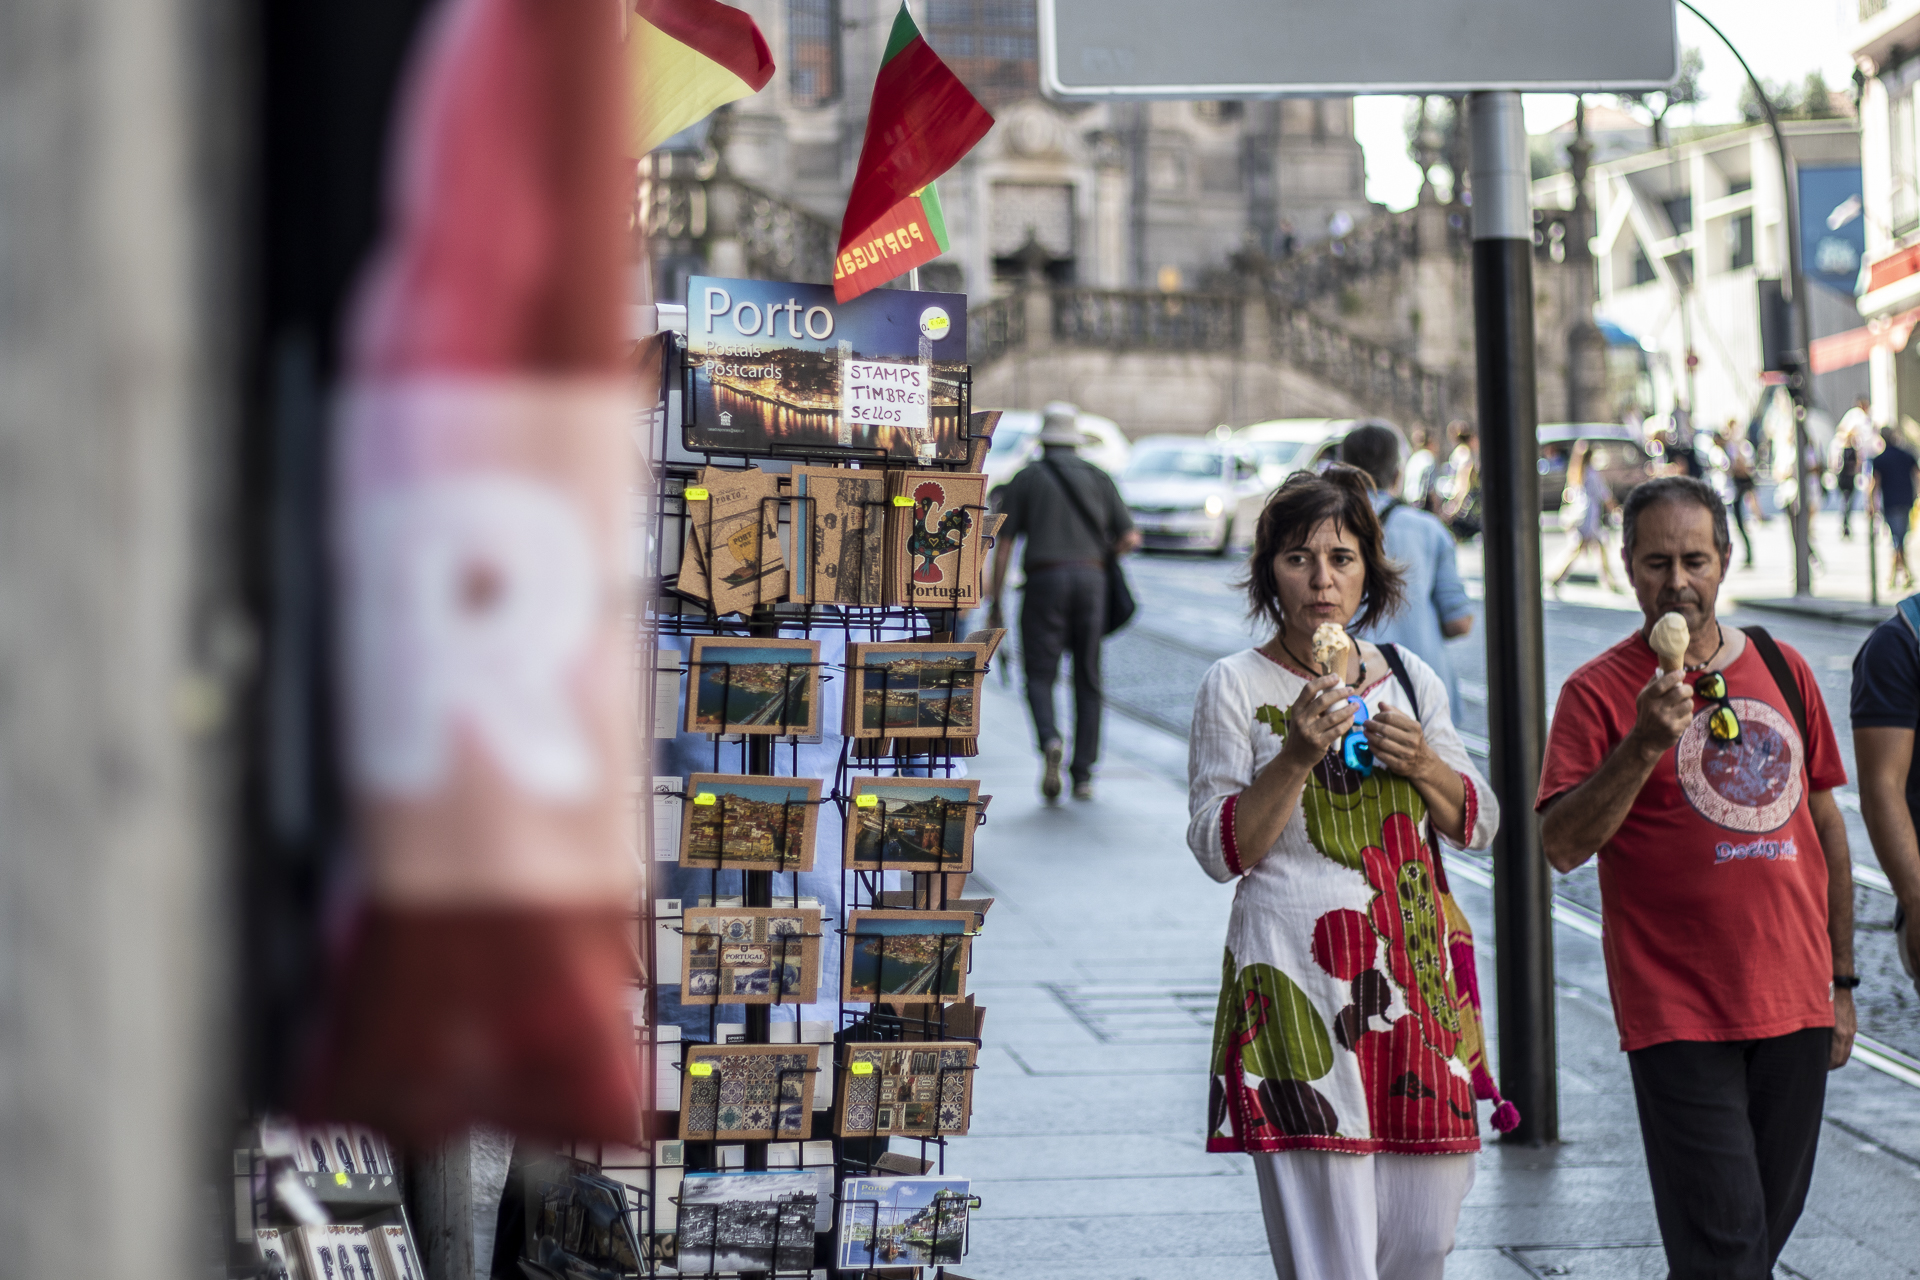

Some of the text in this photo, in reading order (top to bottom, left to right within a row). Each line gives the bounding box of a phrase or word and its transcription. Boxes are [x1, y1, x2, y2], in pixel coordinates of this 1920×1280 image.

[704, 286, 835, 340] Porto
[705, 339, 762, 358] Postais
[705, 359, 783, 379] Postcards
[850, 365, 921, 387] STAMPS
[715, 491, 742, 505] PORTO
[732, 531, 753, 545] PORT
[904, 582, 973, 600] Portugal
